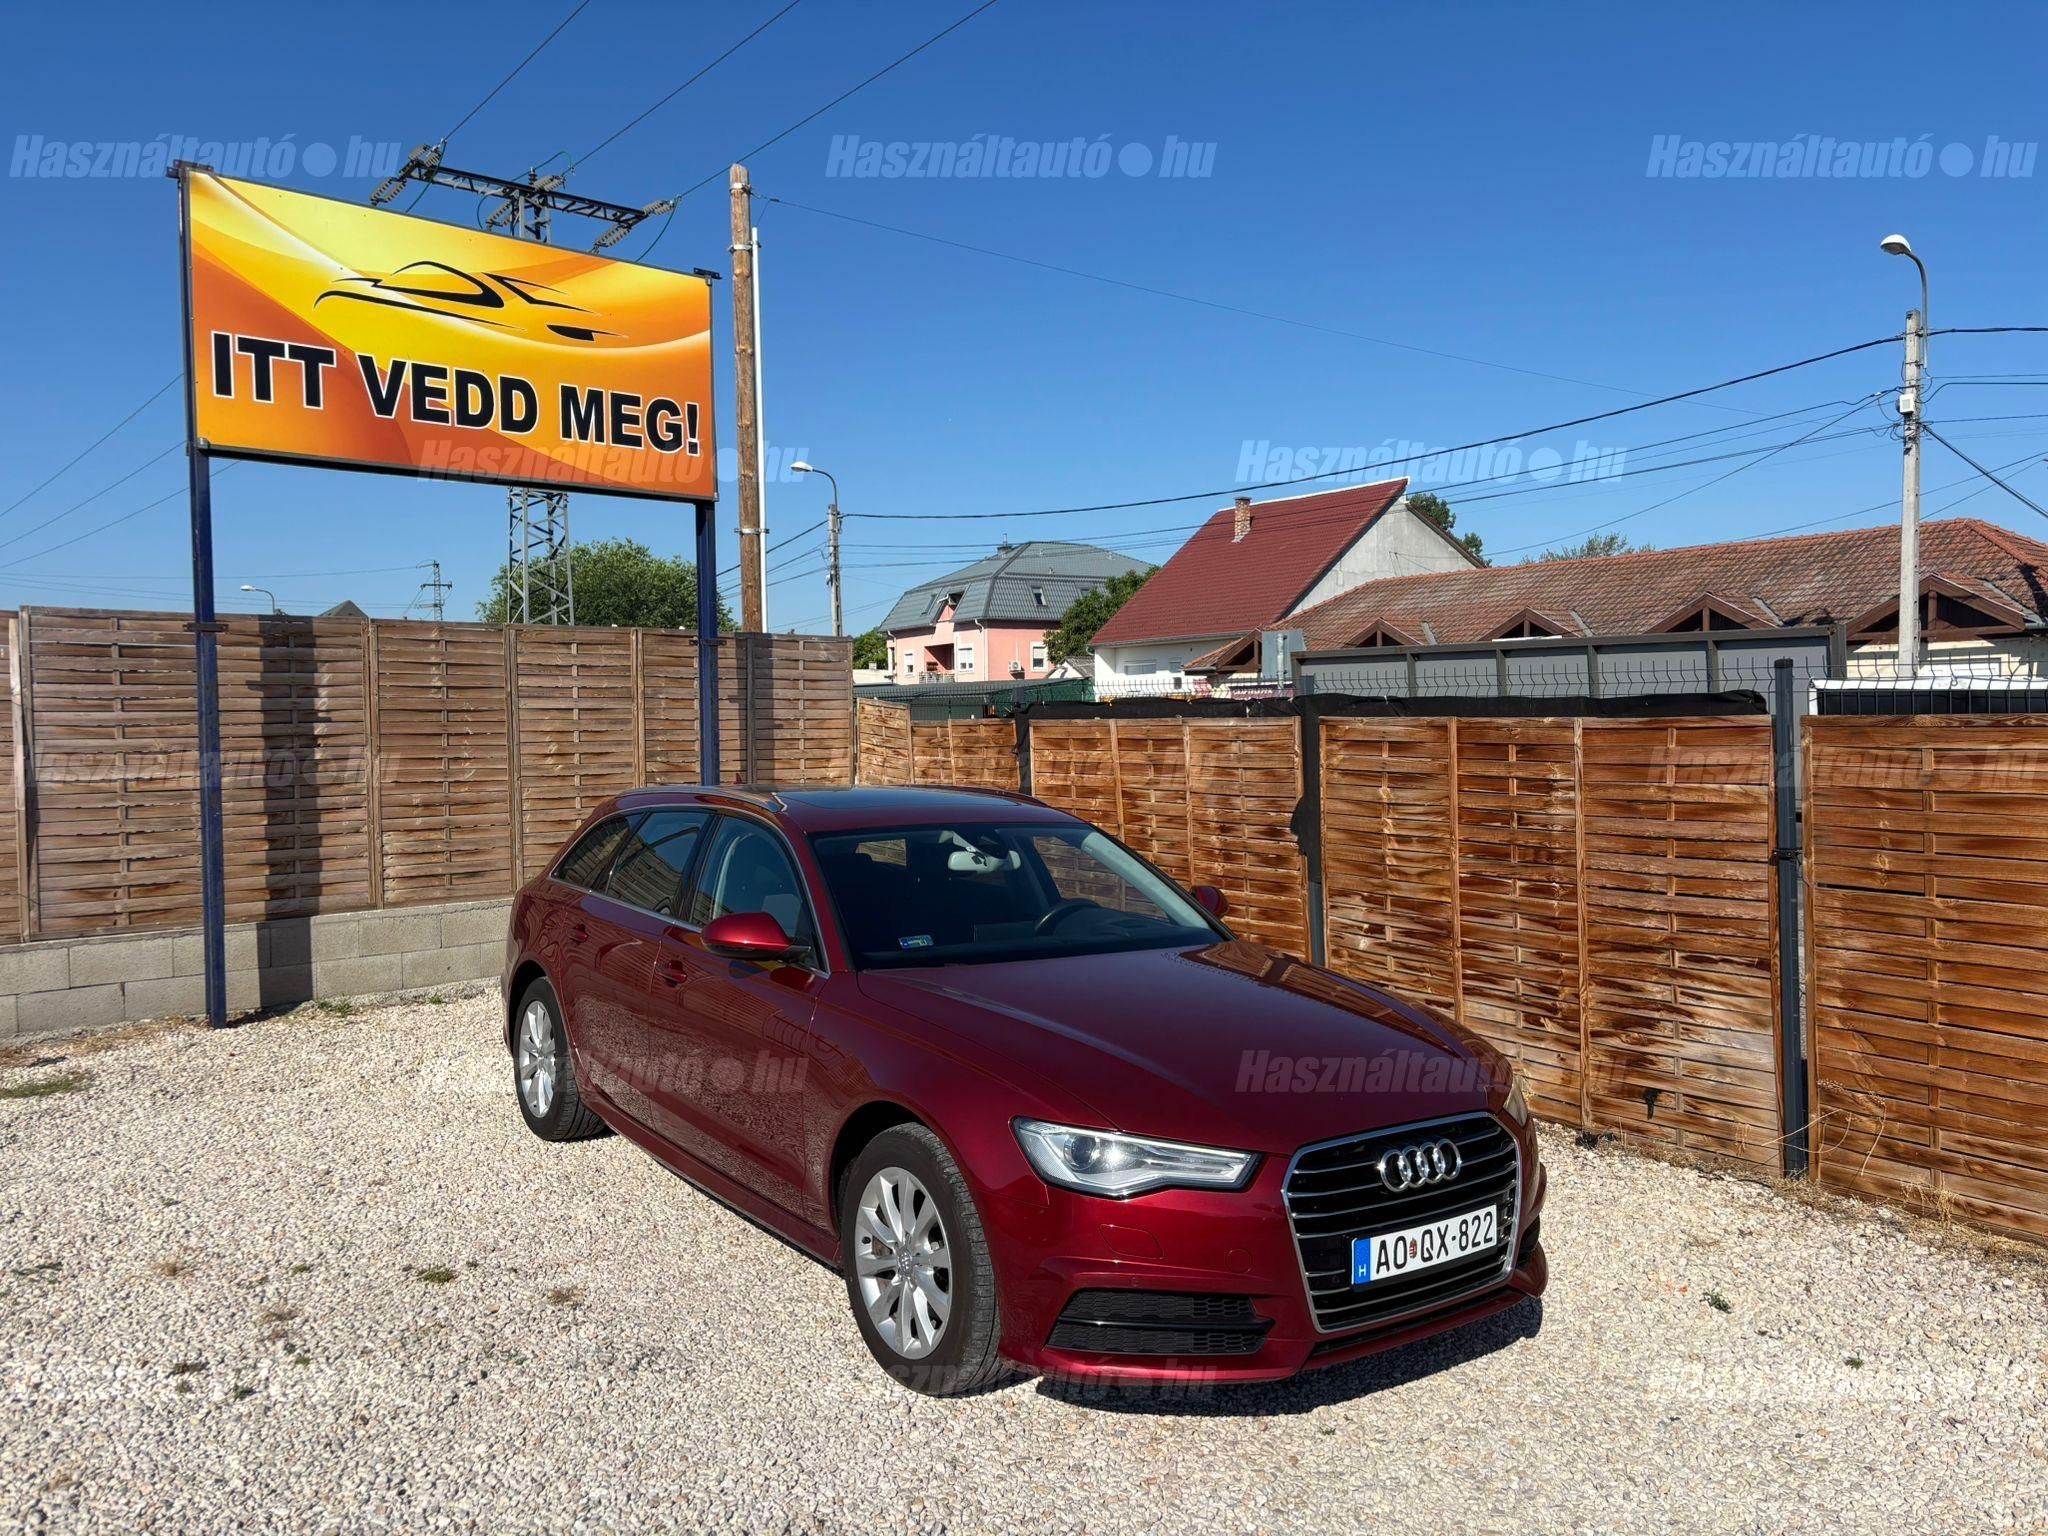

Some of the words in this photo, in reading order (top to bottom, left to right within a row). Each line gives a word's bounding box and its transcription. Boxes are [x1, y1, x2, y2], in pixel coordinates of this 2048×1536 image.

[211, 330, 336, 411] ITT
[355, 351, 539, 435] VEDD
[559, 382, 700, 458] MEG!
